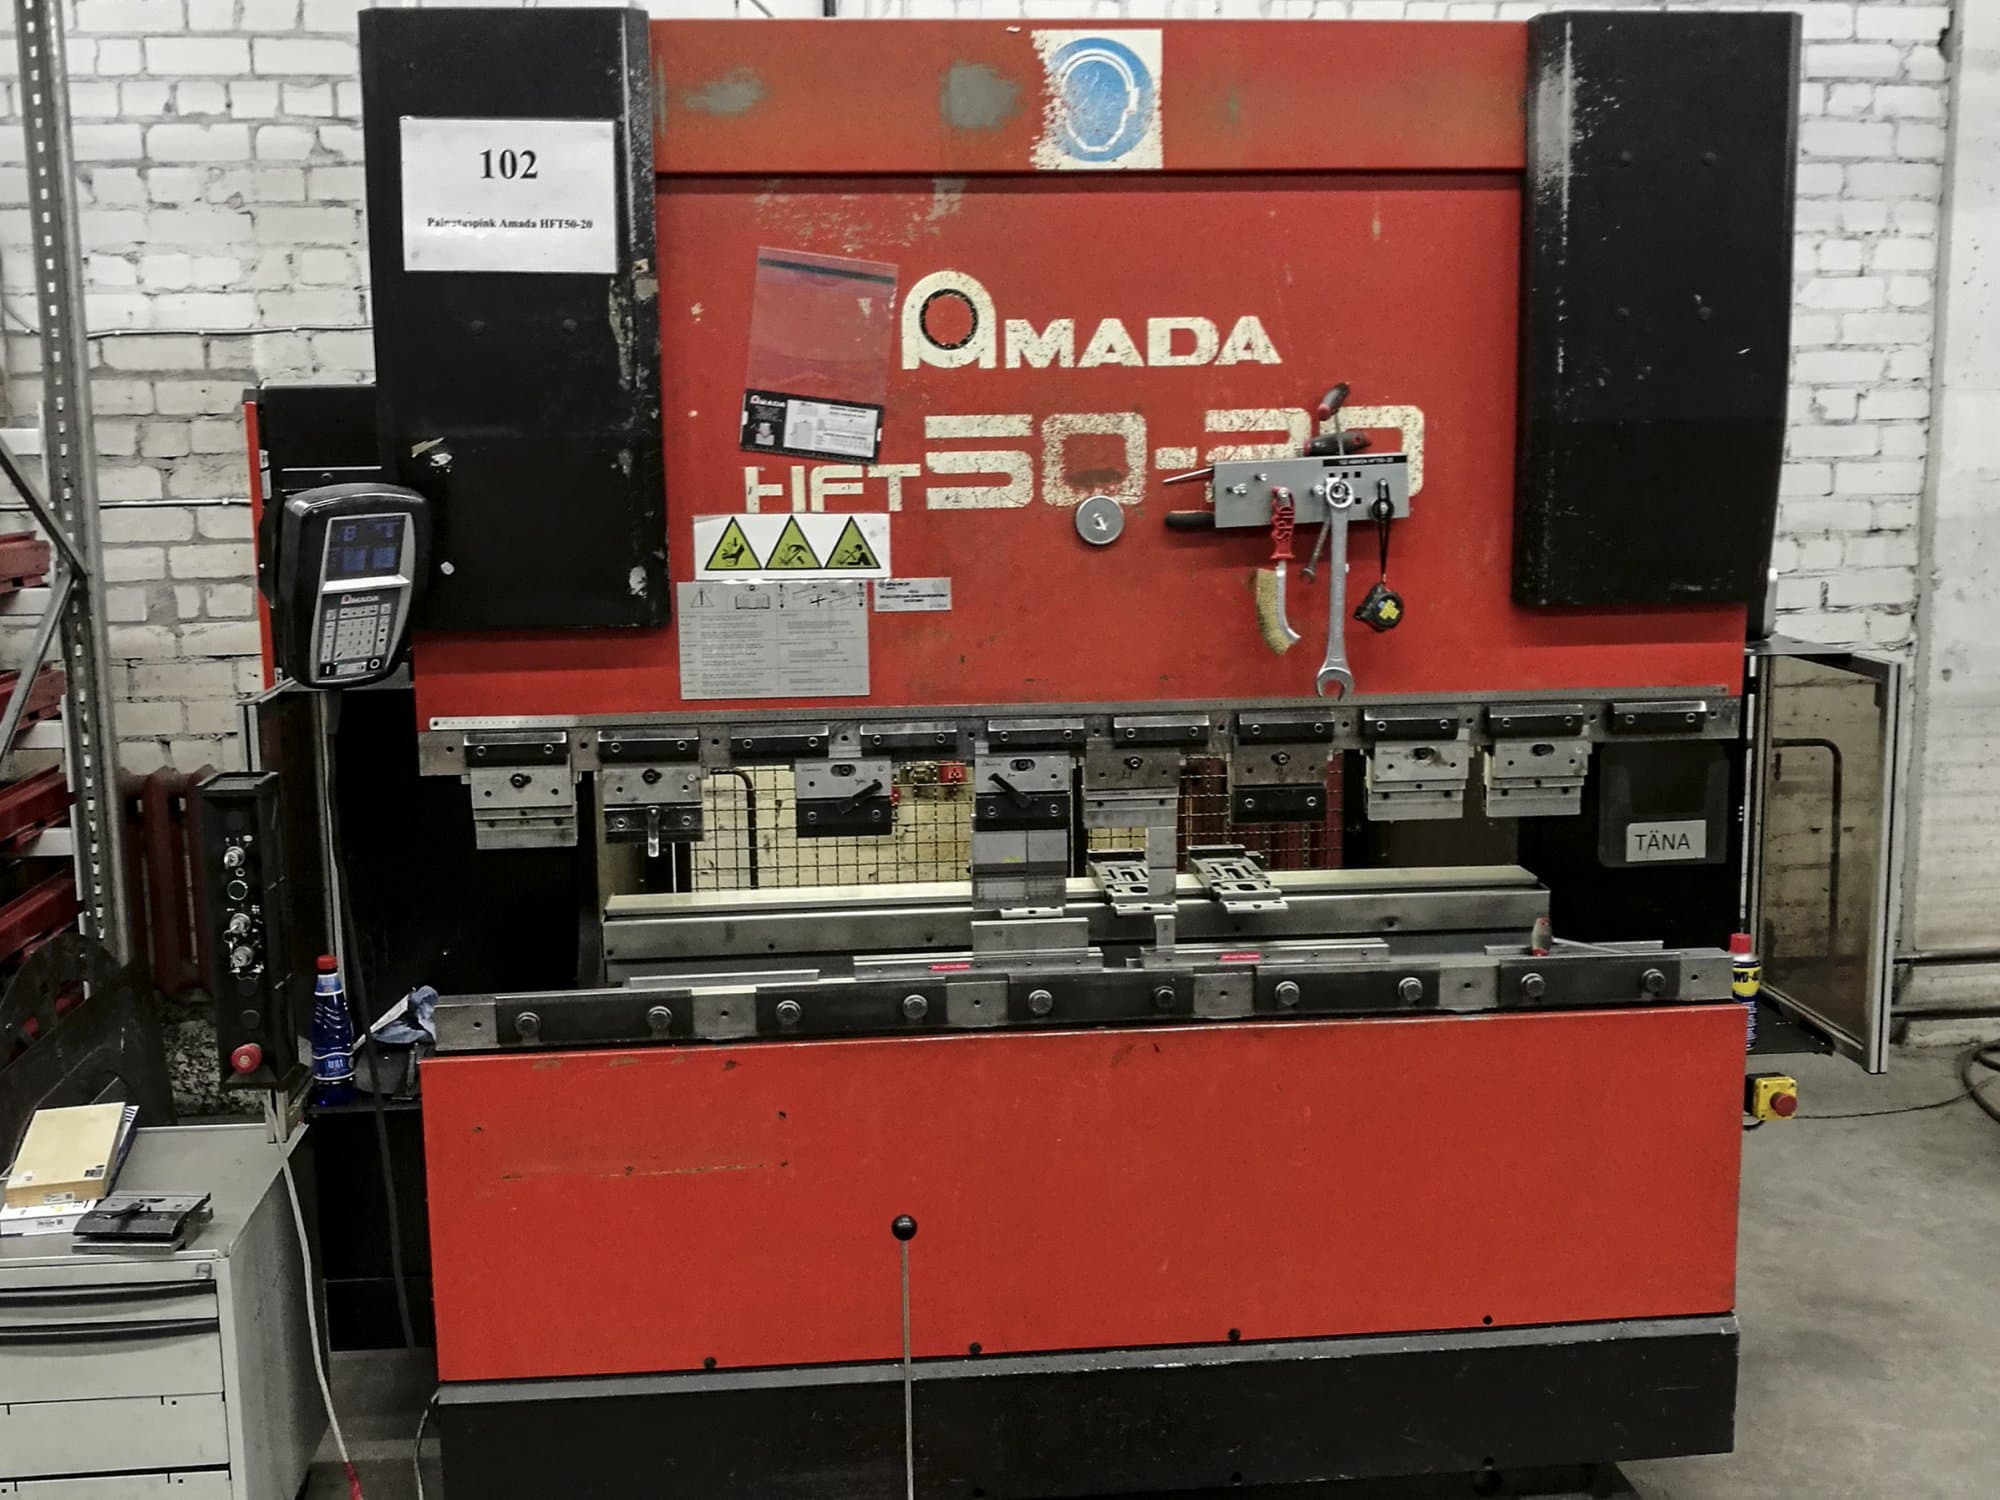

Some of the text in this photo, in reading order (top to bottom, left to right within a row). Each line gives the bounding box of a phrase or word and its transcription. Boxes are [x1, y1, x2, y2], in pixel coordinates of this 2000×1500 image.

[480, 149, 538, 179] 102
[500, 218, 537, 229] Amada
[540, 218, 593, 229] HFT50-20
[902, 270, 1282, 370] AMADA
[1635, 830, 1690, 851] TÄNA
[1732, 971, 1760, 983] WD-4
